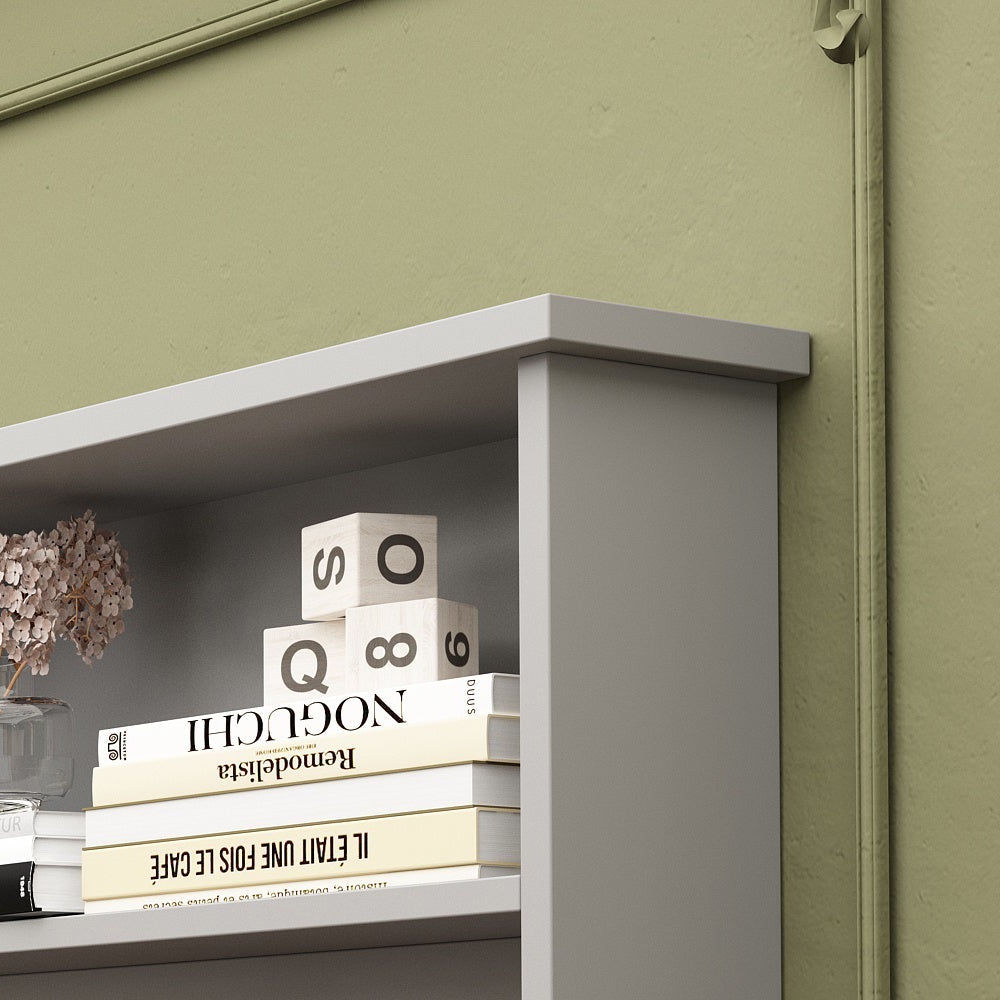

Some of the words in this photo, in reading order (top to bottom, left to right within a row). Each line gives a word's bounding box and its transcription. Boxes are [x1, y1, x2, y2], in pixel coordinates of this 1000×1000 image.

[313, 546, 345, 590] S
[377, 534, 424, 584] O
[281, 640, 328, 694] Q
[366, 633, 417, 668] 8
[466, 679, 476, 715] DUUS
[187, 690, 406, 752] NOGUCHI
[217, 747, 356, 783] Remodelista
[196, 849, 213, 875] LE
[220, 845, 255, 873] FOIS
[261, 841, 294, 869] UNE
[300, 835, 347, 866] ÉTAIT
[353, 832, 369, 860] IL
[150, 851, 191, 886] CAFÉ
